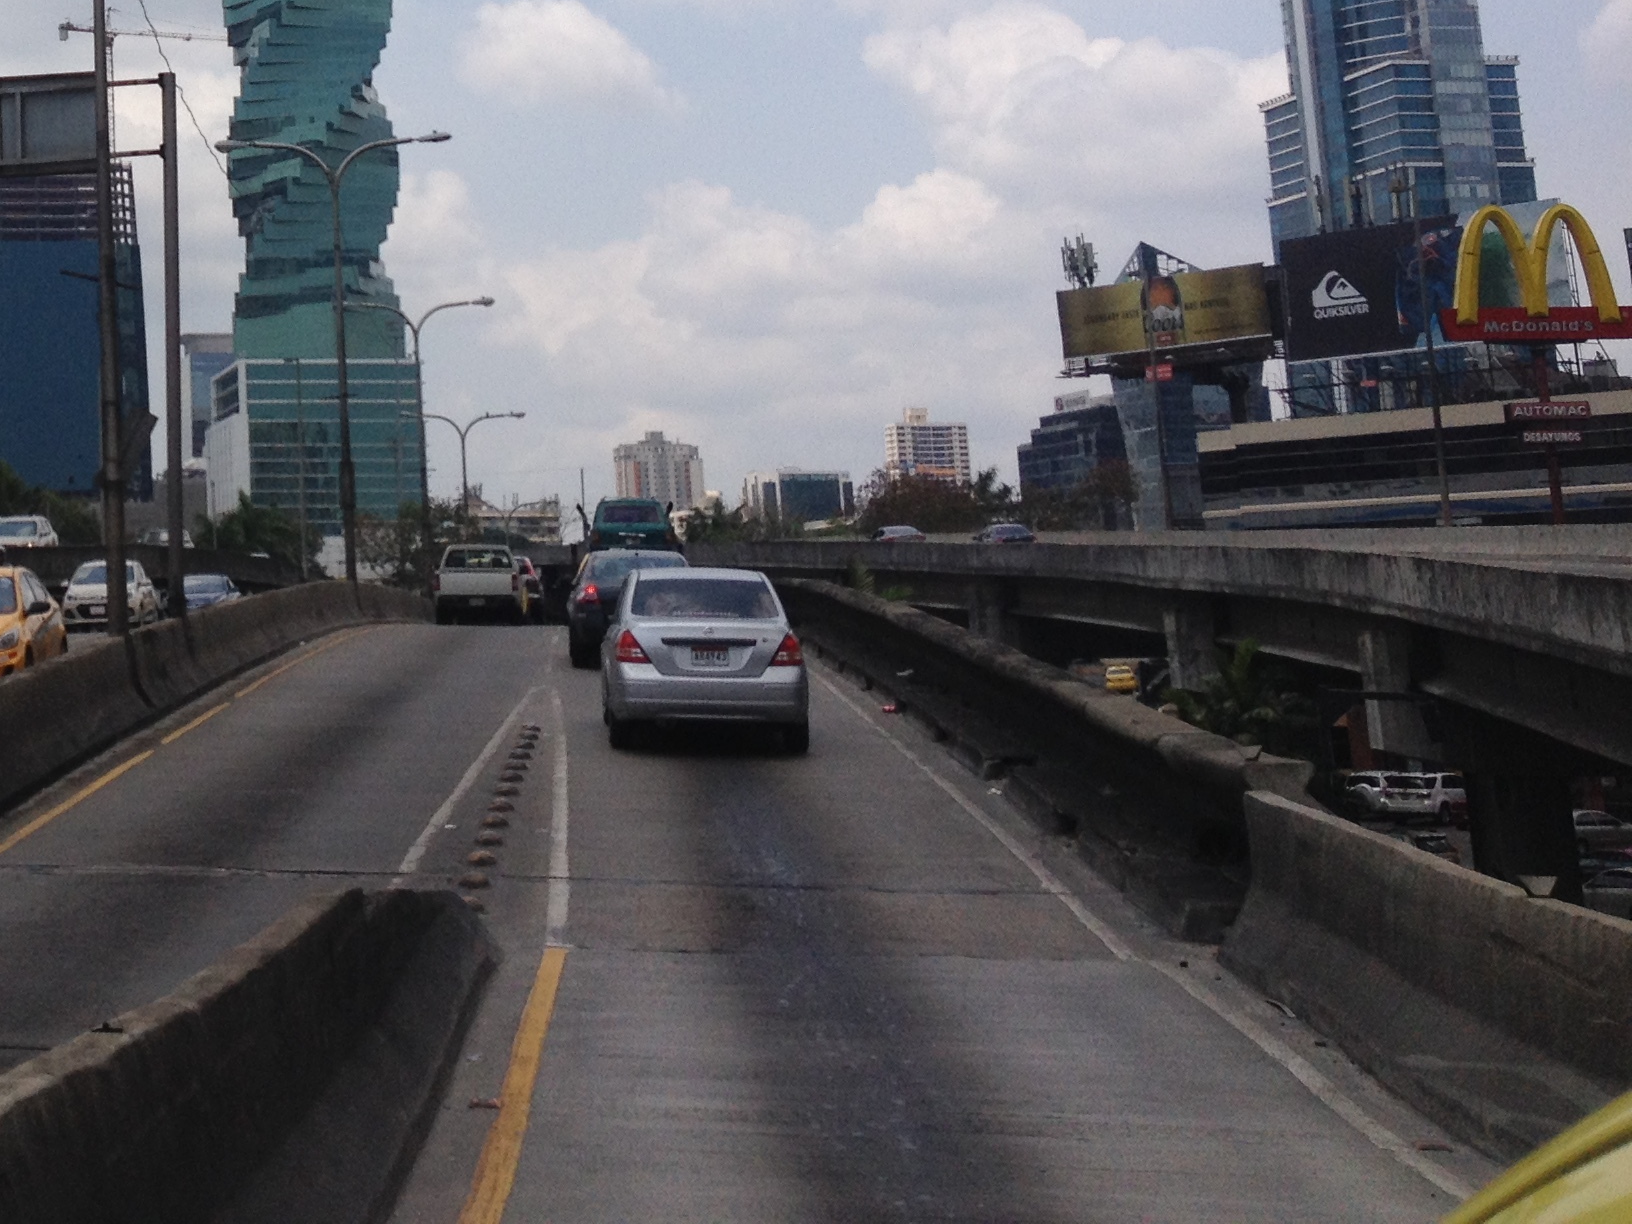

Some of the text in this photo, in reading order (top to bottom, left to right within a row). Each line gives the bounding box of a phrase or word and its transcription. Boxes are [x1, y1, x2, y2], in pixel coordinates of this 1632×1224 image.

[1313, 304, 1369, 320] QUIKSILVER
[1483, 319, 1594, 333] McDonald's
[1513, 405, 1587, 418] AUTOMAC
[1523, 432, 1581, 443] DESAYUNOS
